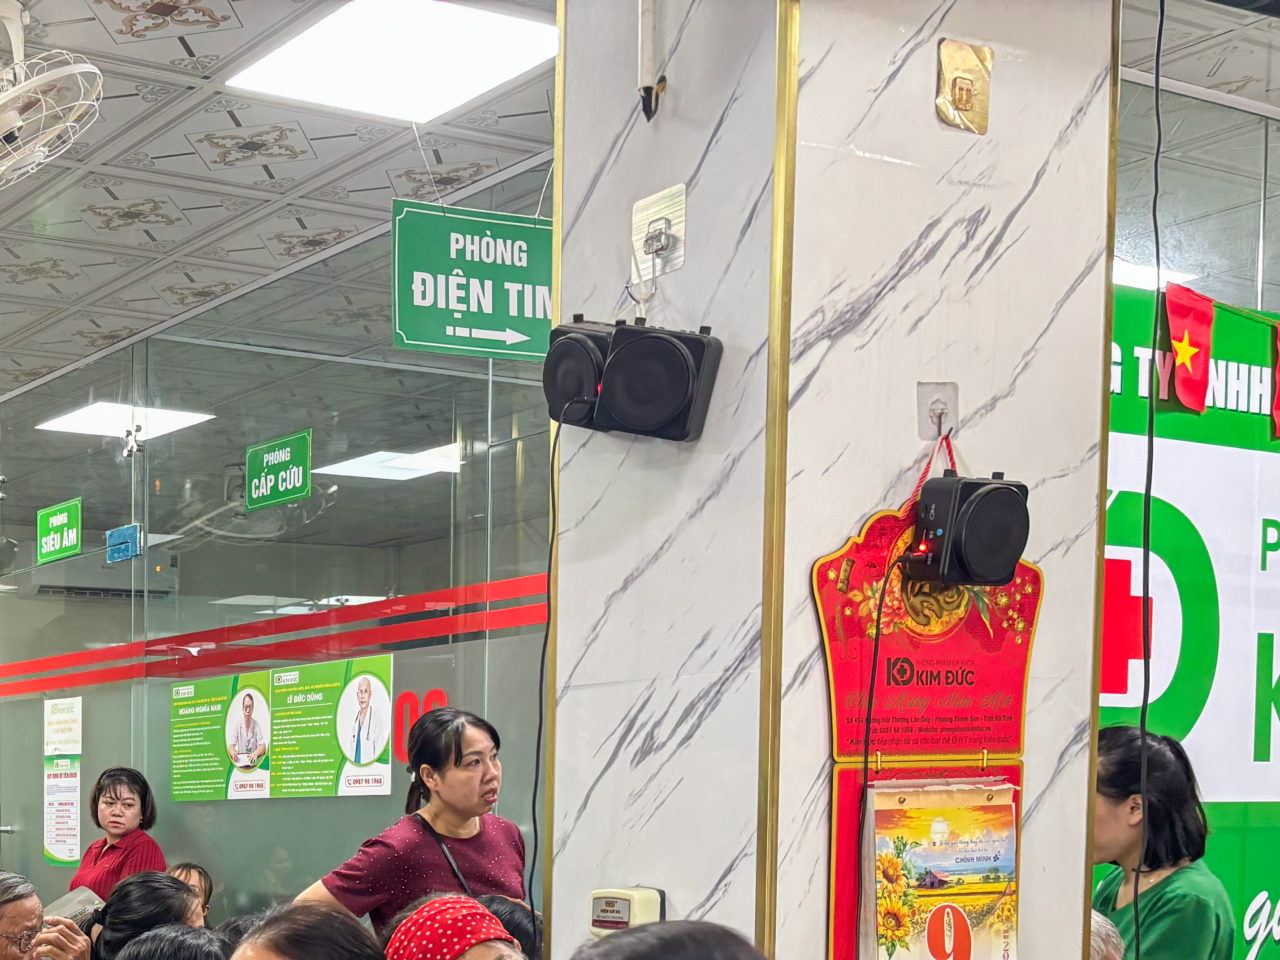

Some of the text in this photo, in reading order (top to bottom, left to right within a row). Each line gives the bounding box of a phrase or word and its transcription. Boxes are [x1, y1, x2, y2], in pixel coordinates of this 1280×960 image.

[450, 230, 528, 268] PHÒNG
[412, 268, 493, 319] ĐIỆN
[1205, 358, 1272, 416] NHH
[263, 447, 291, 468] PHÒNG
[251, 464, 303, 499] CẤP CỨU
[49, 512, 68, 529] PHÒNG
[41, 527, 77, 554] SIÊU ÂM
[916, 669, 941, 686] KIM
[945, 666, 975, 687] ĐỨC
